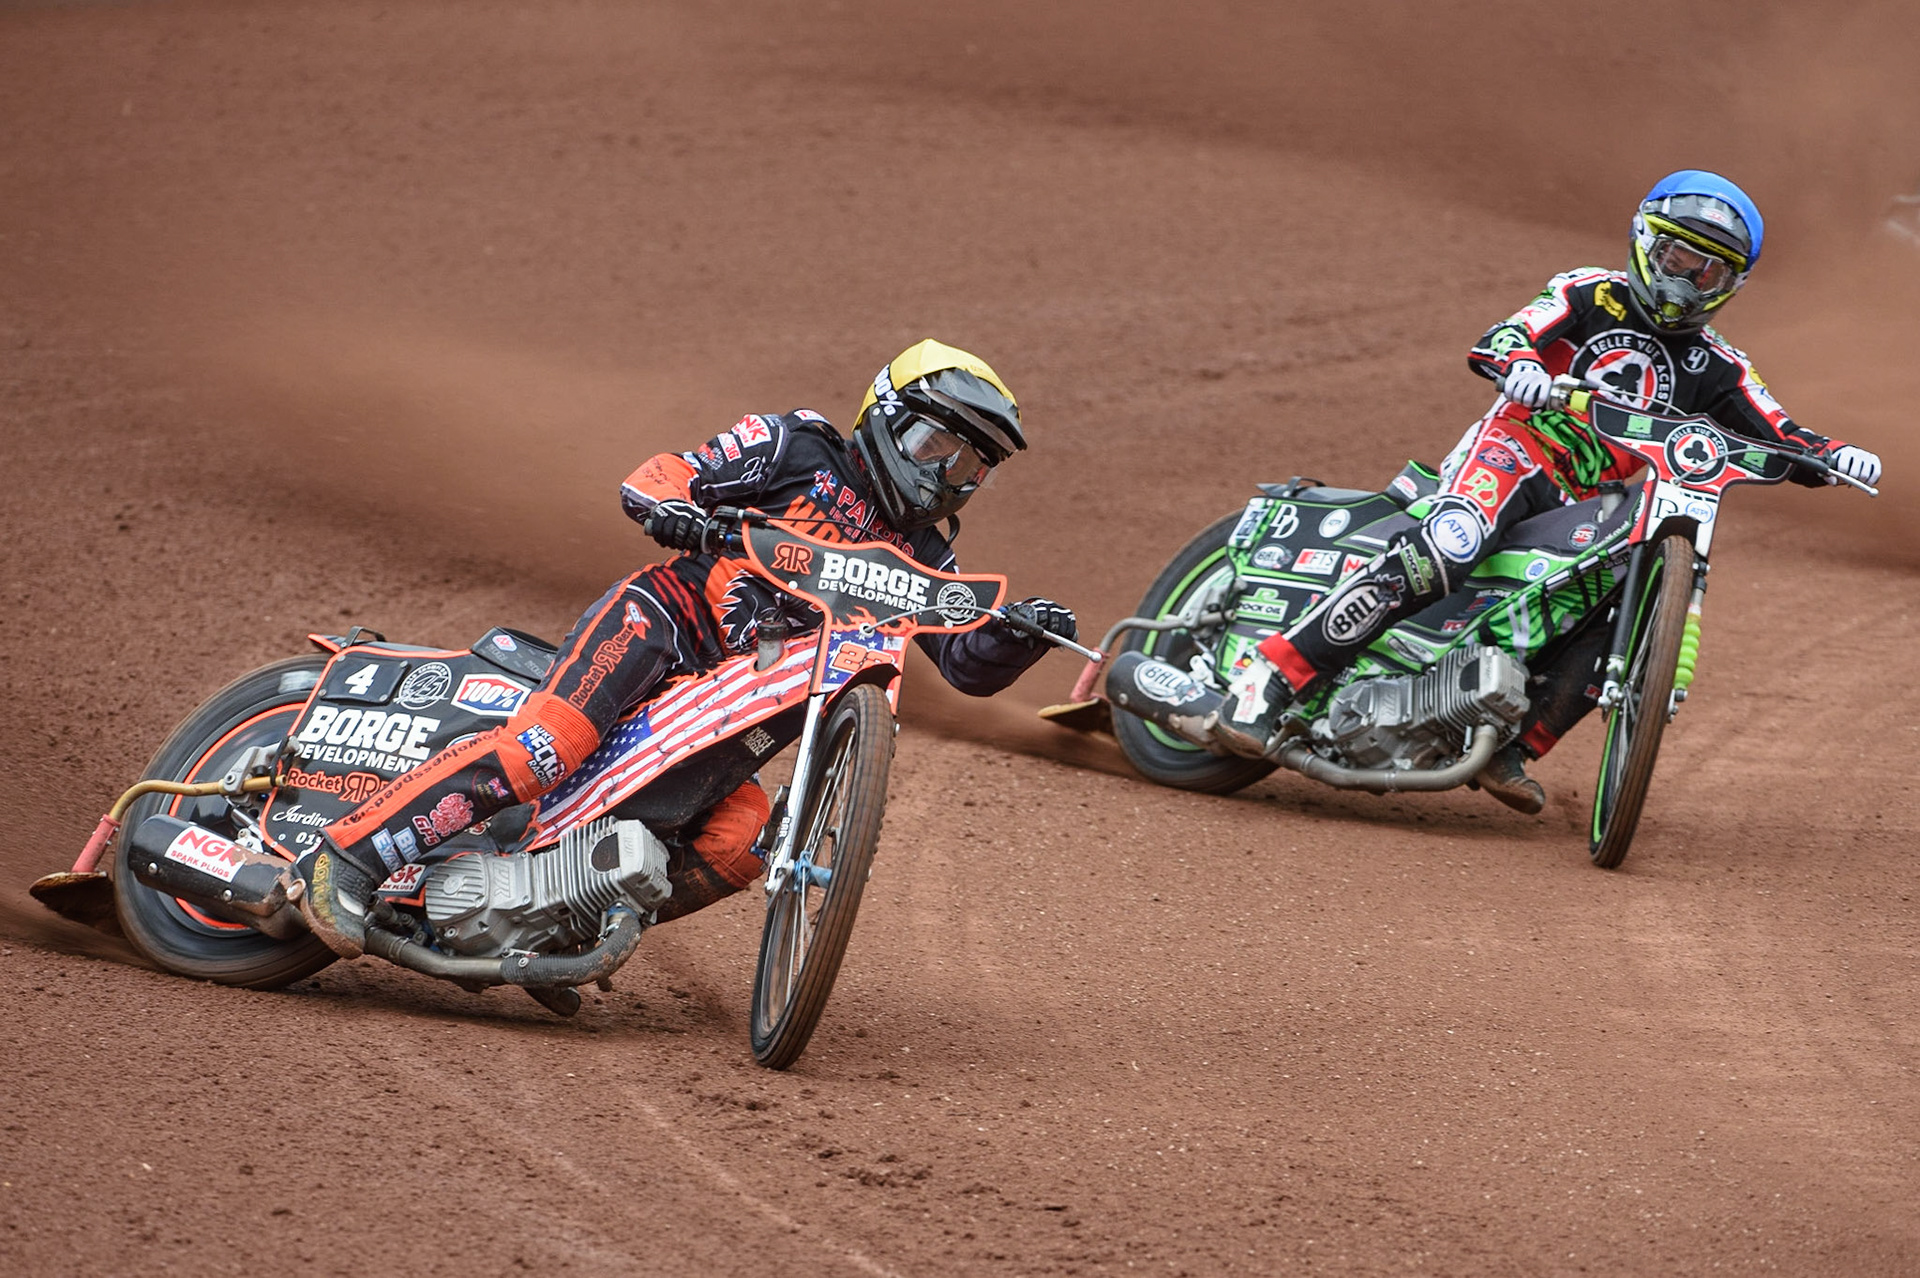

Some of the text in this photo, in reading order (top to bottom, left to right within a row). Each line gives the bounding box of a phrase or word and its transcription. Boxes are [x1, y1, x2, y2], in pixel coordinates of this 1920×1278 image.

[1590, 336, 1671, 400] BELLE VUE ACES
[1671, 427, 1693, 443] BELLE
[1696, 427, 1712, 438] VUE
[1442, 518, 1471, 549] ATPI
[819, 552, 931, 605] BORGE
[818, 579, 926, 616] DEVELOPMENT
[1265, 605, 1282, 615] OIL
[344, 663, 380, 695] 4
[570, 667, 606, 709] Rocket
[464, 680, 518, 709] 100%
[299, 706, 441, 762] BORGE
[533, 725, 556, 743] LUKE
[295, 743, 422, 774] DEVELOPMENT
[288, 768, 343, 792] Rocket
[527, 760, 550, 788] RACING
[272, 805, 333, 828] Jardin
[413, 816, 441, 846] GPS
[178, 829, 242, 867] NGK
[171, 850, 230, 879] SPARK PLUGS
[389, 864, 423, 885] GK
